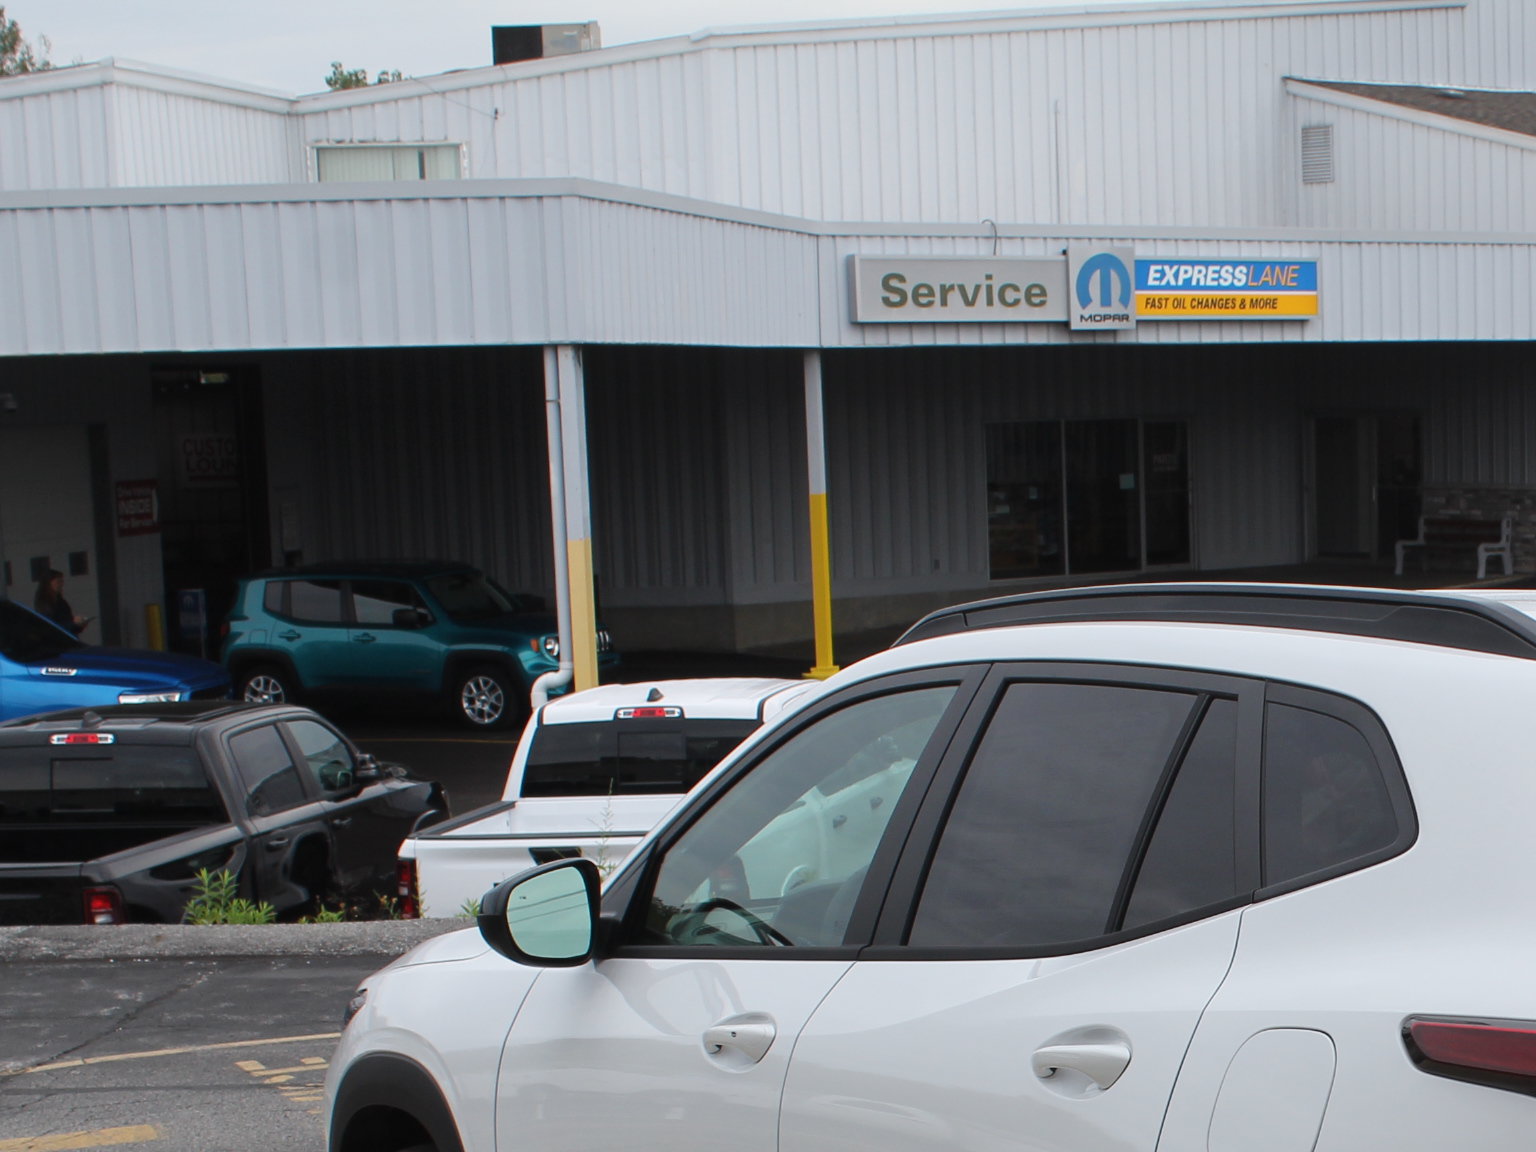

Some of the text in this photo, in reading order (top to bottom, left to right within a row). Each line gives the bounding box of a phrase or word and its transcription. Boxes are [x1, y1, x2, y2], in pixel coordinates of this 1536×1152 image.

[881, 272, 1048, 308] Service
[1145, 298, 1278, 310] FAST OIL CHANGES & MORE
[1080, 314, 1130, 323] MOPAR
